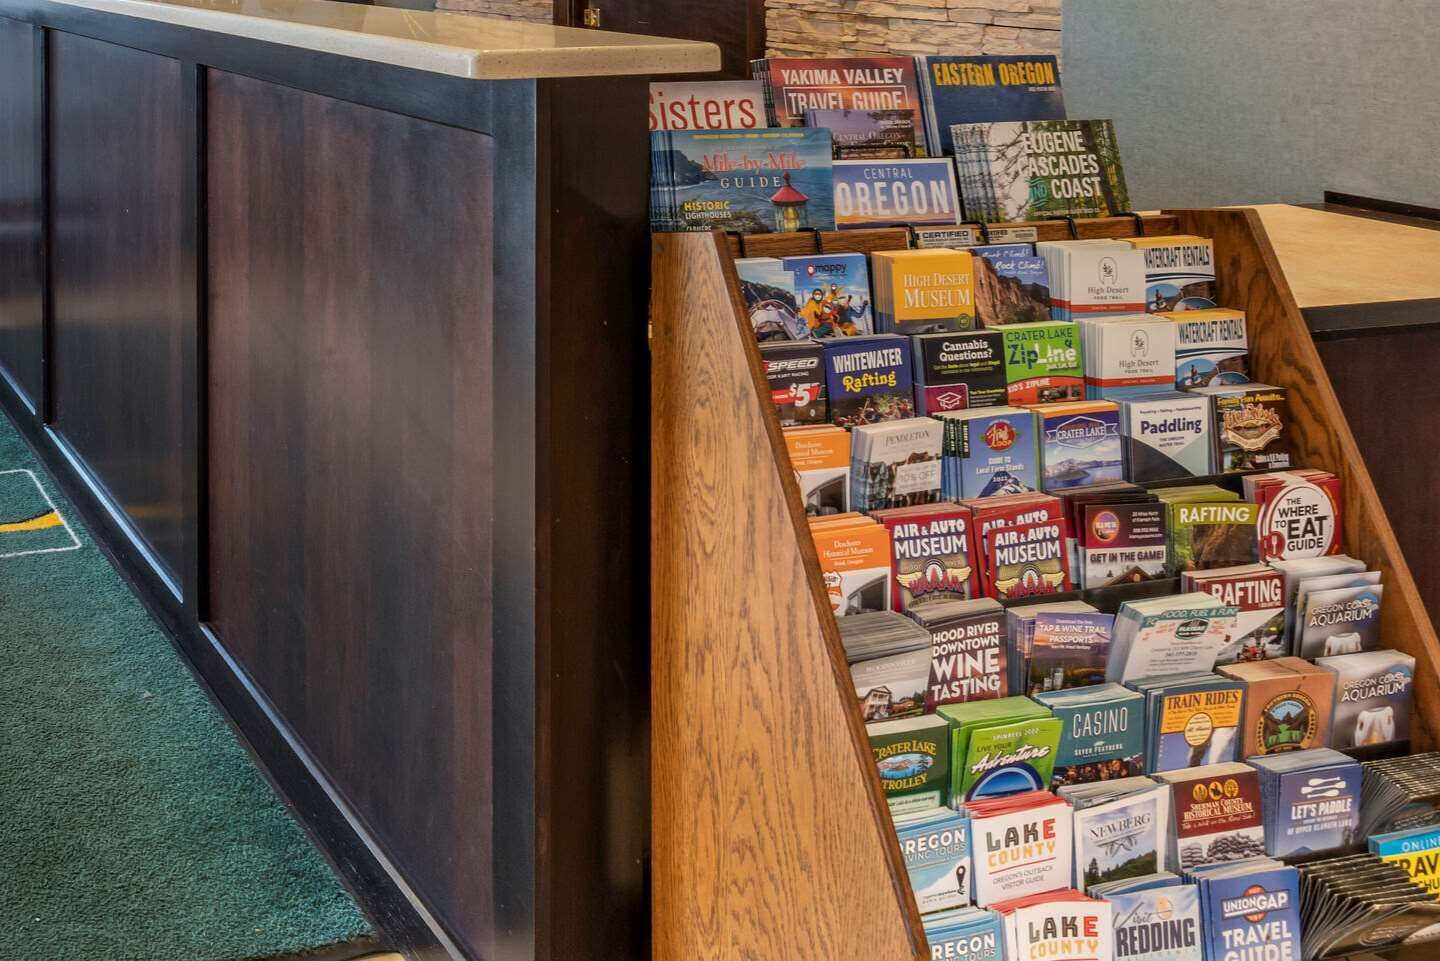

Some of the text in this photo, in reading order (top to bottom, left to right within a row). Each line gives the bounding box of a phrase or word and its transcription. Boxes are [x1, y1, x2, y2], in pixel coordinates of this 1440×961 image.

[781, 68, 904, 86] YAKIMA VALLEY
[932, 62, 1056, 87] EASTERN OREGON
[851, 91, 903, 110] GUIDE
[1023, 130, 1086, 154] EUGENE
[702, 151, 805, 175] Mile-by-Mile
[1017, 153, 1100, 177] CASCADES
[720, 175, 782, 189] GUIDE
[863, 167, 913, 180] CENTRAL
[836, 179, 951, 217] OREGON
[1051, 176, 1102, 200] COAST
[683, 200, 730, 212] HISTORIC
[685, 211, 732, 220] LIGHTHOUSES
[922, 230, 969, 239] CERTIFIED
[1144, 245, 1210, 269] WATERCRAFT RENTALS
[815, 263, 848, 275] mappy
[903, 272, 971, 288] HIGH DESERT
[903, 287, 971, 310] MUSEUM
[1087, 285, 1129, 296] High Desert
[1006, 327, 1073, 343] CRATER LAKE
[1178, 318, 1244, 345] WATERCRAFT RENTALS
[939, 348, 993, 362] Questions?
[942, 339, 989, 352] Cannabis
[1007, 342, 1077, 369] ZipLine
[768, 358, 818, 372] SPEED
[832, 348, 903, 374] WHITEWATER
[1119, 359, 1160, 369] High Desert
[842, 370, 897, 392] Rafting
[789, 382, 810, 407] $5
[1057, 426, 1105, 440] CRATER LAKE
[1140, 417, 1203, 435] Paddling
[885, 430, 929, 447] PENDLETON
[976, 467, 990, 475] Local
[991, 466, 1005, 474] Farm
[1278, 504, 1319, 518] WHERE
[1286, 498, 1302, 506] THE
[982, 509, 1049, 536] AIR AUTO
[1179, 506, 1250, 524] RAFTING
[893, 518, 966, 539] AIR & AUTO
[995, 525, 1060, 547] AIR & AUTO
[1274, 515, 1329, 540] TO EAT
[894, 535, 968, 560] MUSEUM
[995, 540, 1061, 566] MUSEUM
[1286, 538, 1325, 553] GUIDE
[1089, 550, 1164, 562] GET IN THE GAME!
[1211, 578, 1281, 607] RAFTING
[1311, 597, 1373, 616] OREGON COAST
[1309, 608, 1373, 627] AQUARIUM
[933, 621, 1000, 645] HOOD RIVER
[1039, 624, 1053, 633] TAP
[1061, 624, 1084, 633] WINE
[1084, 624, 1107, 634] TRAIL
[1049, 634, 1093, 644] PASSPORTS
[932, 634, 1000, 658] DOWNTOWN
[931, 647, 1000, 683] WINE
[931, 673, 1001, 702] TASTING
[1343, 671, 1406, 691] OREGON COAST
[1167, 690, 1239, 710] TRAIN RIDES
[1341, 682, 1405, 703] AQUARIUM
[1072, 706, 1129, 739] CASINO
[872, 739, 937, 761] CRATER LAKE
[976, 742, 1012, 753] LIVE YOUR
[971, 743, 1052, 775] Adventure
[881, 773, 929, 790] TROLLEY
[1183, 808, 1222, 821] HISTORICAL
[1222, 802, 1253, 815] MUSEUM
[1190, 797, 1244, 811] SHERMAN COUNTY
[1291, 798, 1353, 821] LET'S PADDLE
[986, 818, 1056, 853] LAKE
[1089, 812, 1152, 840] NEWBERG
[935, 842, 966, 856] TOURS
[987, 839, 1057, 868] COUNTY
[1401, 837, 1440, 853] ONLIN
[992, 865, 1054, 885] OREGON'S OUTBACK
[1001, 876, 1045, 891] VISITOR GUIDE
[1223, 893, 1288, 914] UNION GAP
[1112, 901, 1153, 929] Visit
[1028, 916, 1099, 944] LAKE
[1115, 917, 1196, 958] REDDING
[1222, 921, 1292, 949] TRAVEL
[931, 932, 996, 961] REGON
[1029, 940, 1099, 961] COUNTY
[1223, 942, 1293, 961] GUIDE
